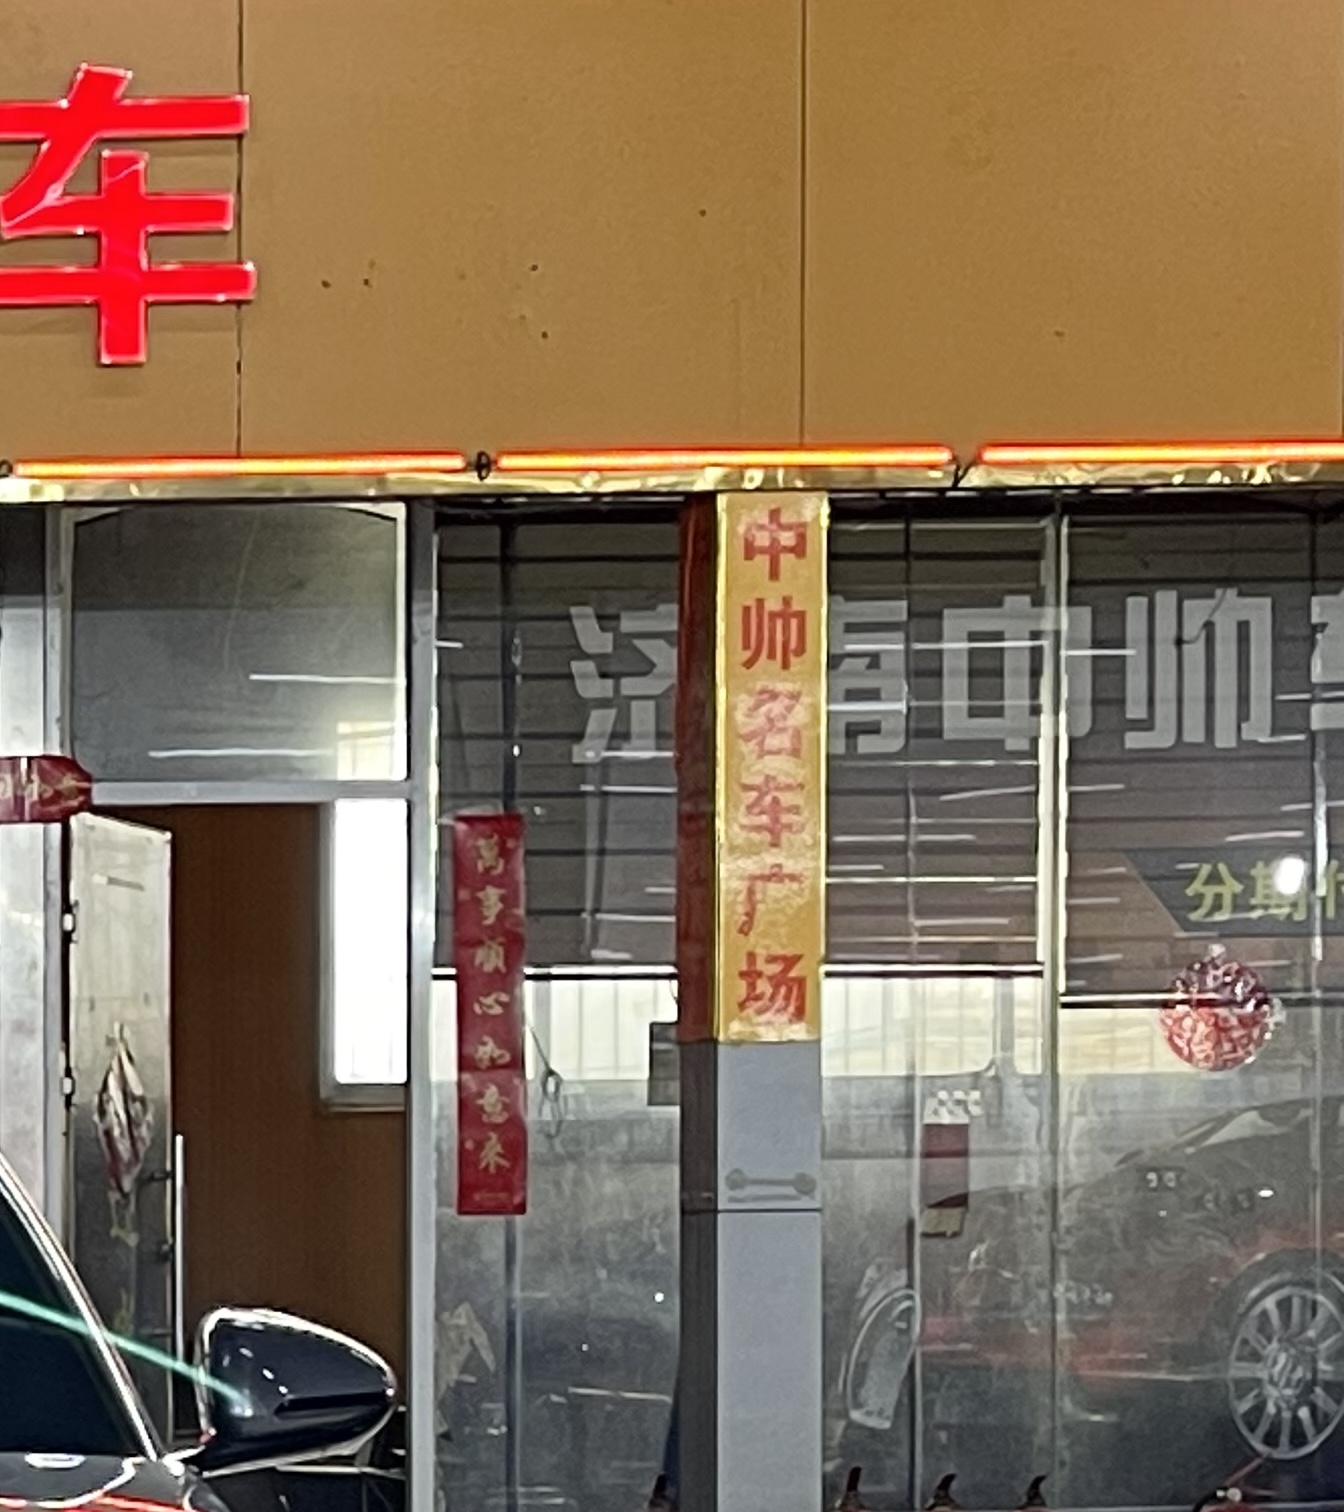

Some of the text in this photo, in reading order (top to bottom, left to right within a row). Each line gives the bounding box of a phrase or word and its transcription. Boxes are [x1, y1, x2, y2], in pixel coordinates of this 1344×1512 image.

[739, 507, 808, 1020] 中帅名车广场
